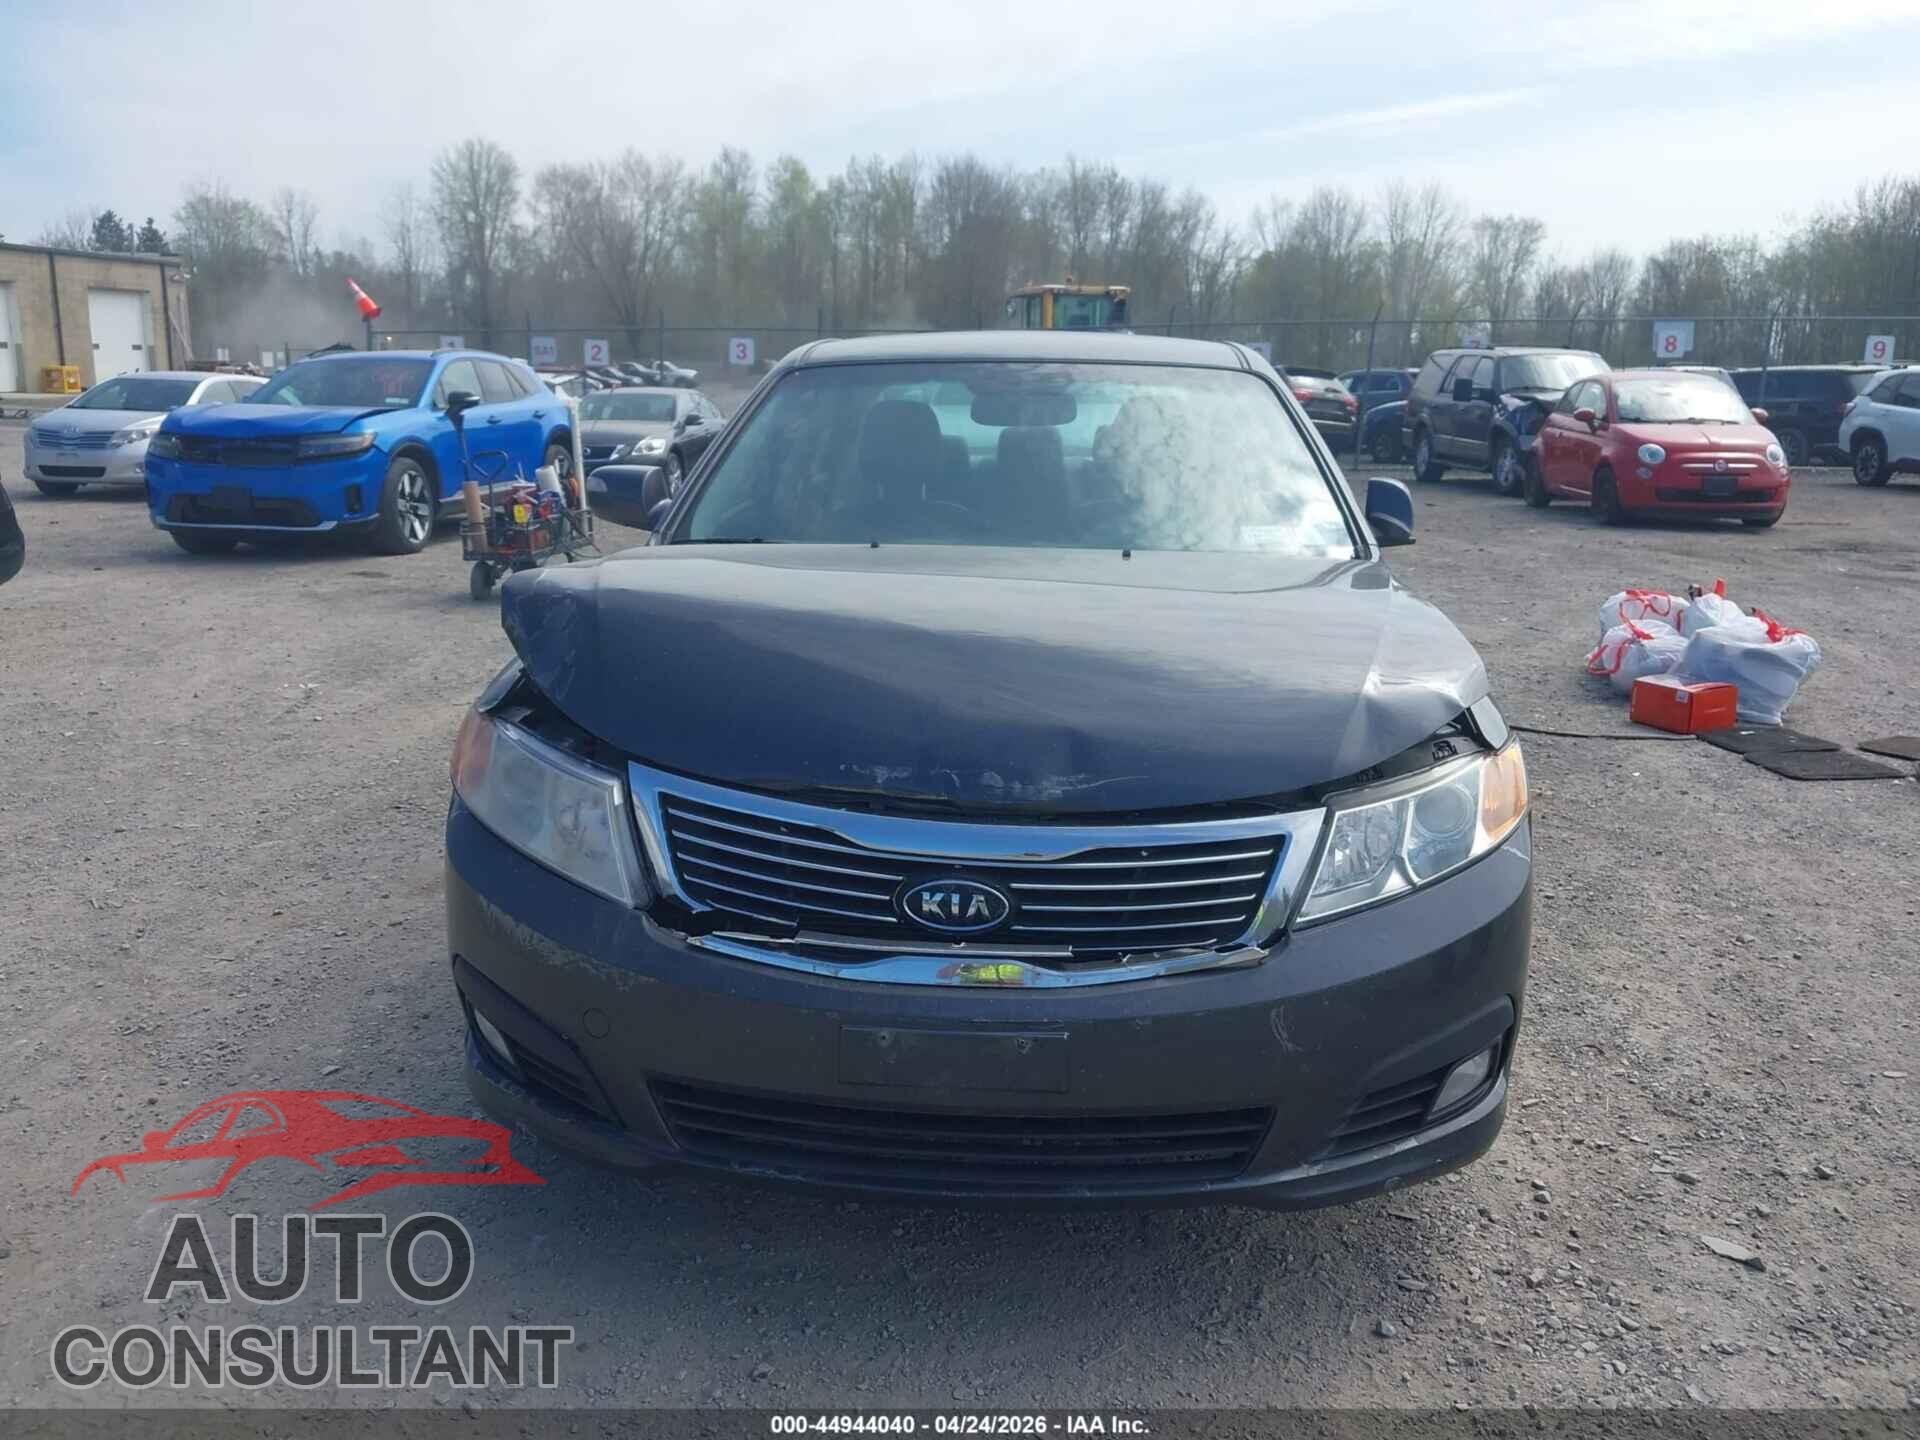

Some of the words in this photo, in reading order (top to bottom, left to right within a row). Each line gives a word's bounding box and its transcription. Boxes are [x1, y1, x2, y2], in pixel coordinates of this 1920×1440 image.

[591, 344, 602, 361] 2
[735, 343, 747, 360] 3
[1664, 335, 1677, 353] 8
[1873, 340, 1886, 359] 9
[921, 891, 991, 919] KIA
